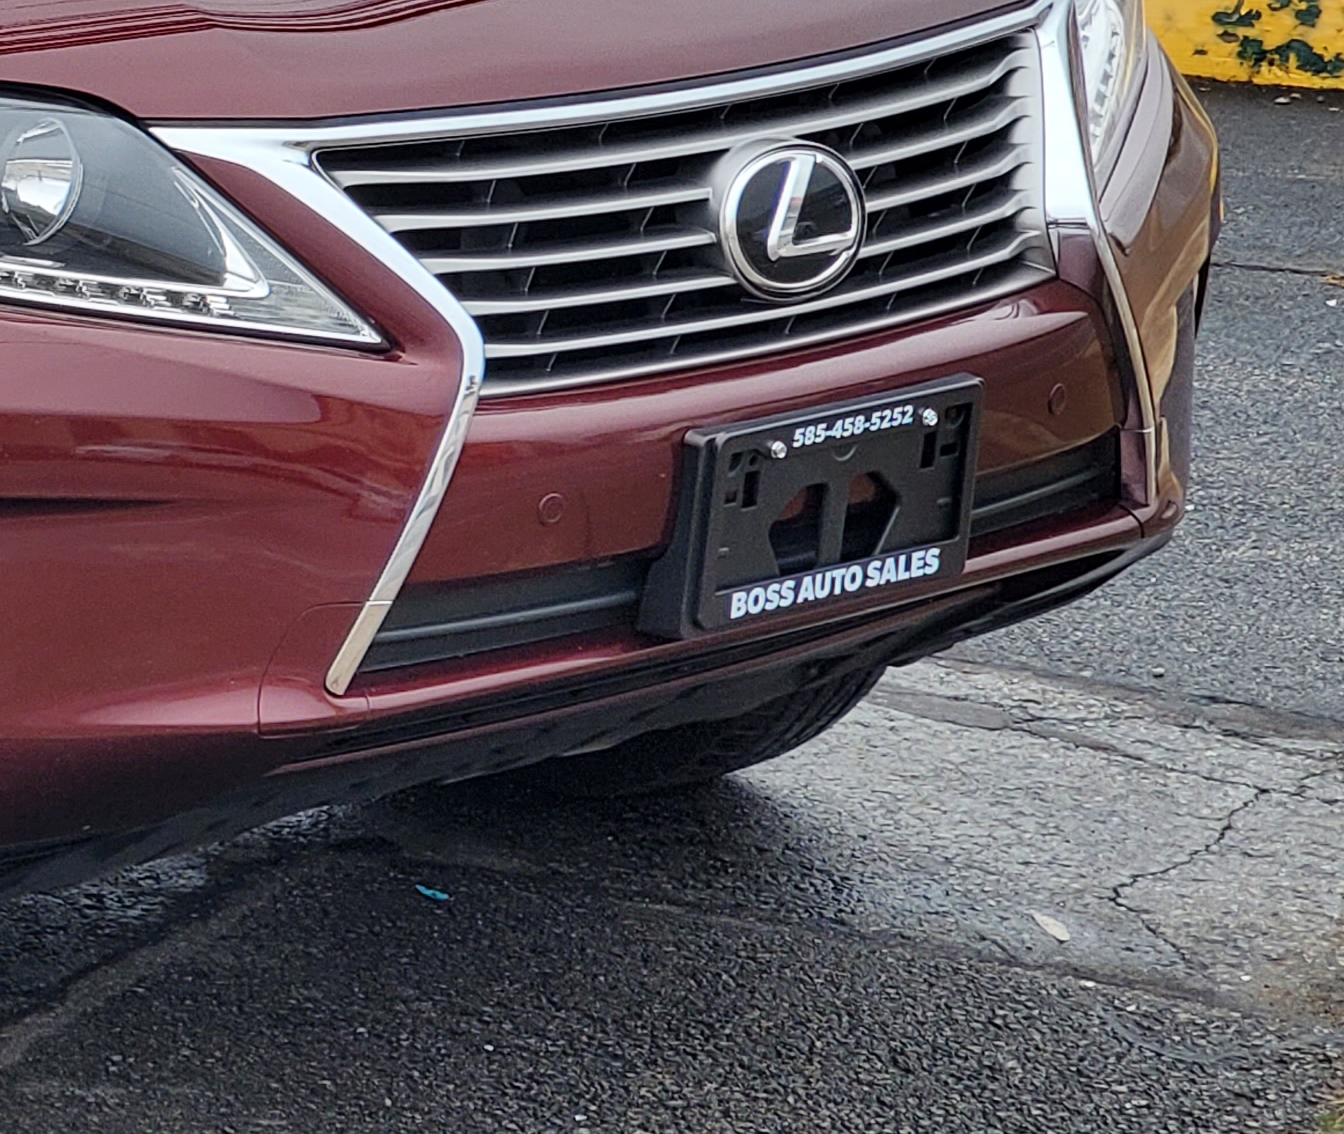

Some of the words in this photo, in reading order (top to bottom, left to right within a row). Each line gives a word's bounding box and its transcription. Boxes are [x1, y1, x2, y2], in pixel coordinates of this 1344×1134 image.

[792, 403, 914, 448] 585-458-5252
[730, 579, 795, 620] BOSS
[796, 563, 863, 604] AUTO
[865, 548, 940, 588] SALES
